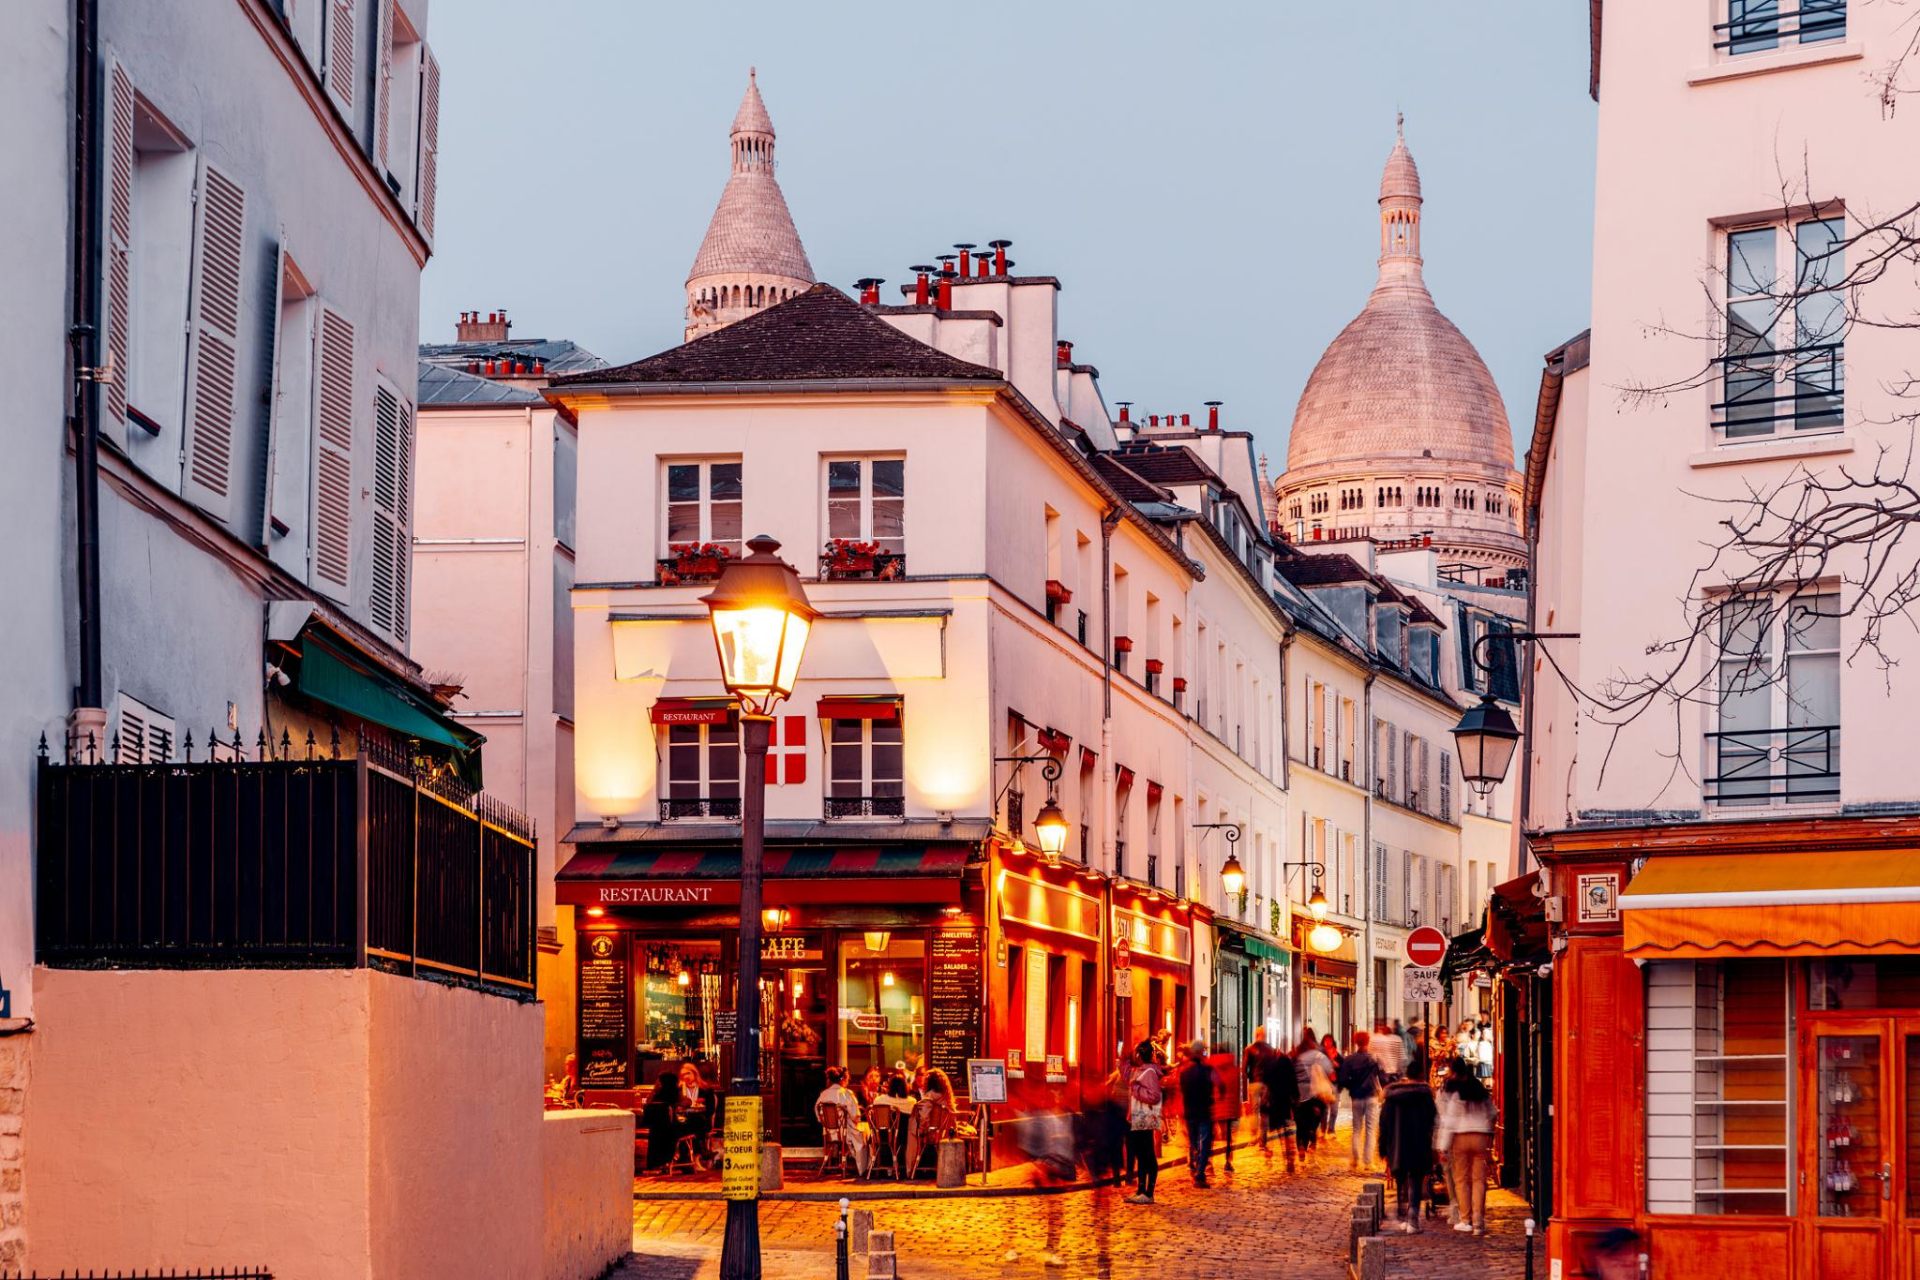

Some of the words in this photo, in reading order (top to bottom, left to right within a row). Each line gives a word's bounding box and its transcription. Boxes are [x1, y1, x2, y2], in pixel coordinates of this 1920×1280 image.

[663, 713, 716, 721] RESTAURANT
[600, 888, 712, 902] RESTAURANT
[1413, 971, 1438, 979] SAUF
[725, 1158, 732, 1170] 3
